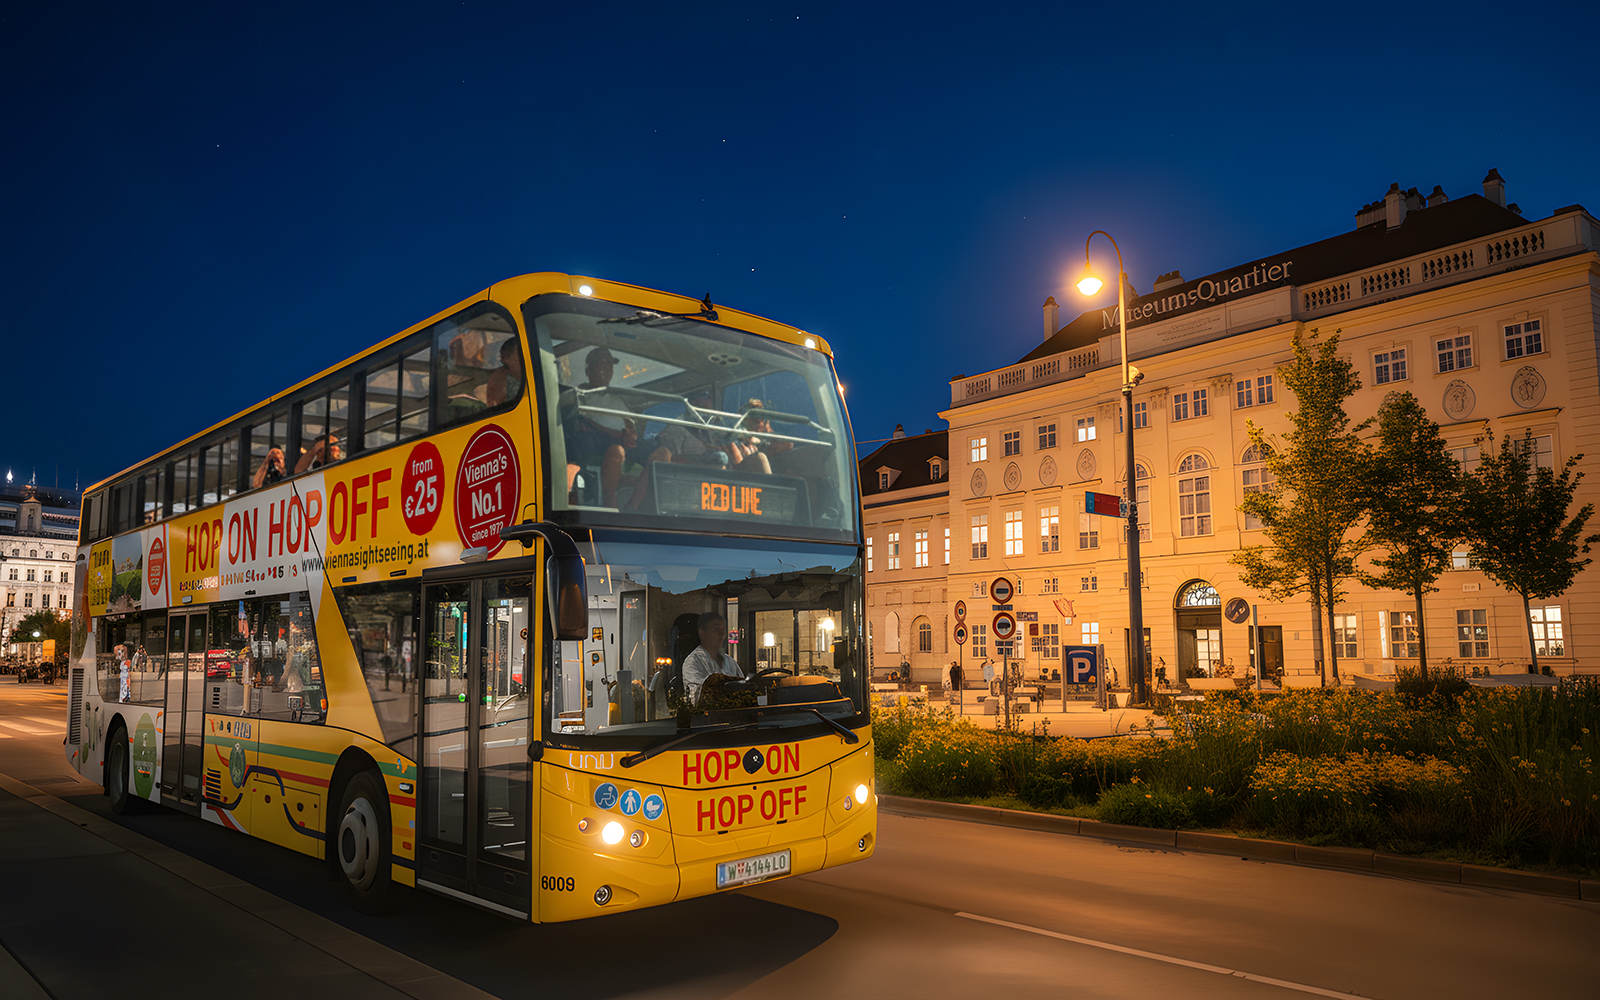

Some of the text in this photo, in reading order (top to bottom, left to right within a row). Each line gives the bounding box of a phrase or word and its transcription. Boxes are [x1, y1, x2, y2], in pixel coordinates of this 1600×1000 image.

[412, 458, 433, 476] from
[464, 453, 508, 484] Vienna's
[405, 475, 438, 518] €25
[471, 481, 502, 520] No.1
[185, 518, 224, 574] HOP
[228, 507, 259, 566] ON
[267, 489, 323, 558] HOP
[329, 467, 393, 546] OFF
[471, 528, 489, 542] since
[301, 538, 429, 573] www.viennasightseeing.at
[1072, 657, 1091, 683] P
[682, 743, 800, 786] HOP ON
[697, 785, 808, 832] HOP OFF
[541, 875, 575, 892] 6009
[728, 864, 737, 880] W
